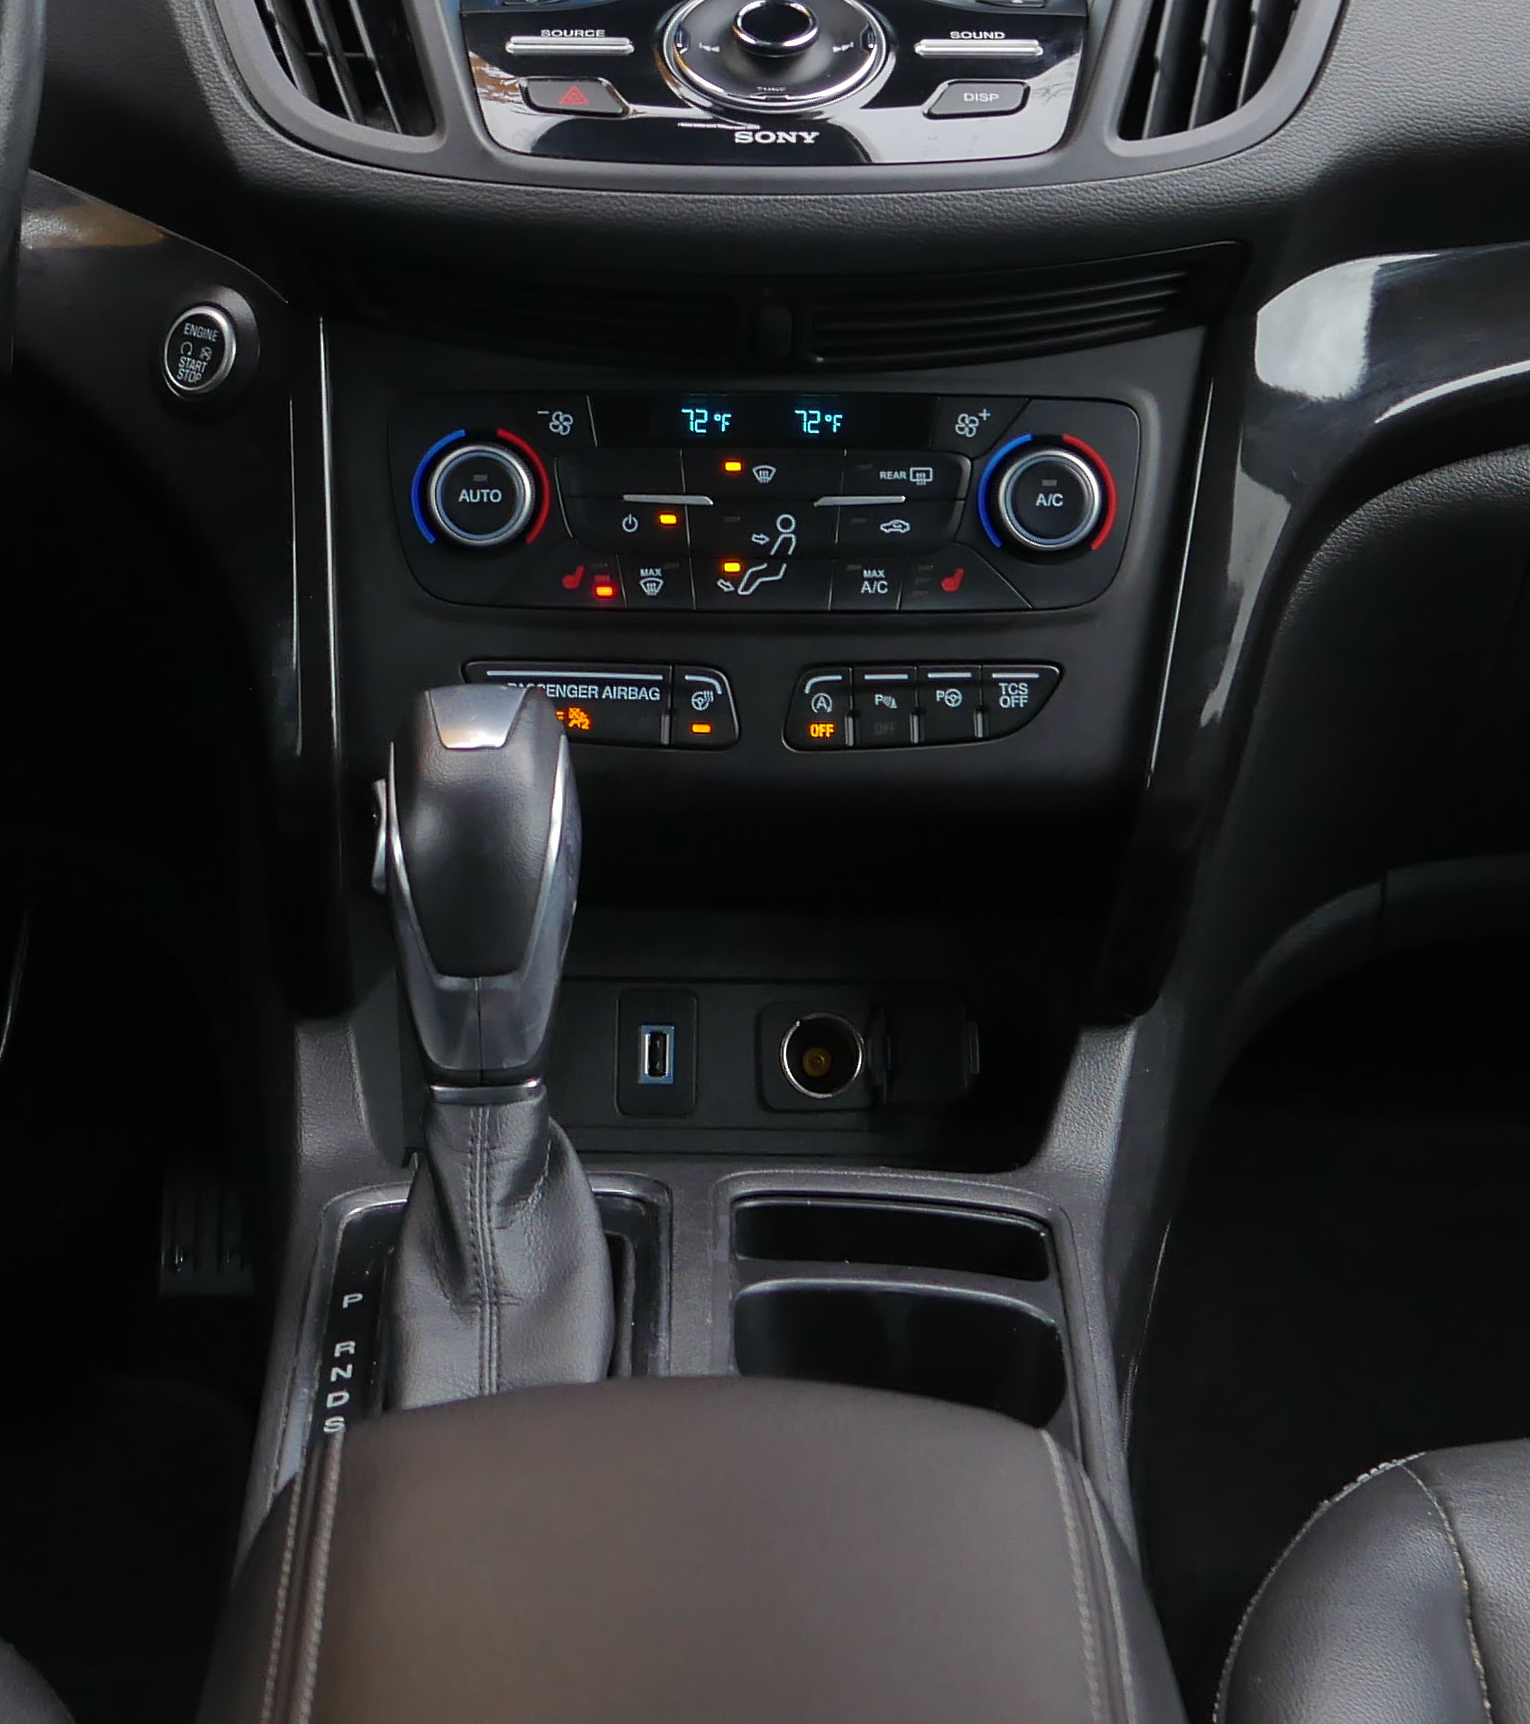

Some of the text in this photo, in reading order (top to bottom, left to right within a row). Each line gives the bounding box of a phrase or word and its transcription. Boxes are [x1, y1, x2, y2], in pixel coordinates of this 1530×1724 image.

[540, 28, 606, 39] SOURCE
[950, 30, 1006, 41] SOUND
[962, 89, 1001, 104] DISP
[733, 129, 821, 146] SONY
[183, 322, 220, 343] ENGINE
[178, 356, 209, 374] START
[176, 369, 203, 384] STOP
[879, 470, 908, 482] REAR
[457, 488, 503, 504] AUTO
[1035, 492, 1064, 508] A/C
[640, 567, 663, 577] MAX
[863, 569, 886, 580] MAX
[860, 579, 889, 596] A/C
[508, 682, 662, 702] ENGER AIRBAG
[999, 682, 1029, 696] TCS
[999, 695, 1029, 709] OFF
[809, 723, 836, 738] OFF
[342, 1292, 364, 1310] P
[334, 1339, 357, 1359] R
[329, 1363, 353, 1383] N
[325, 1390, 350, 1409] D
[322, 1415, 346, 1434] S
